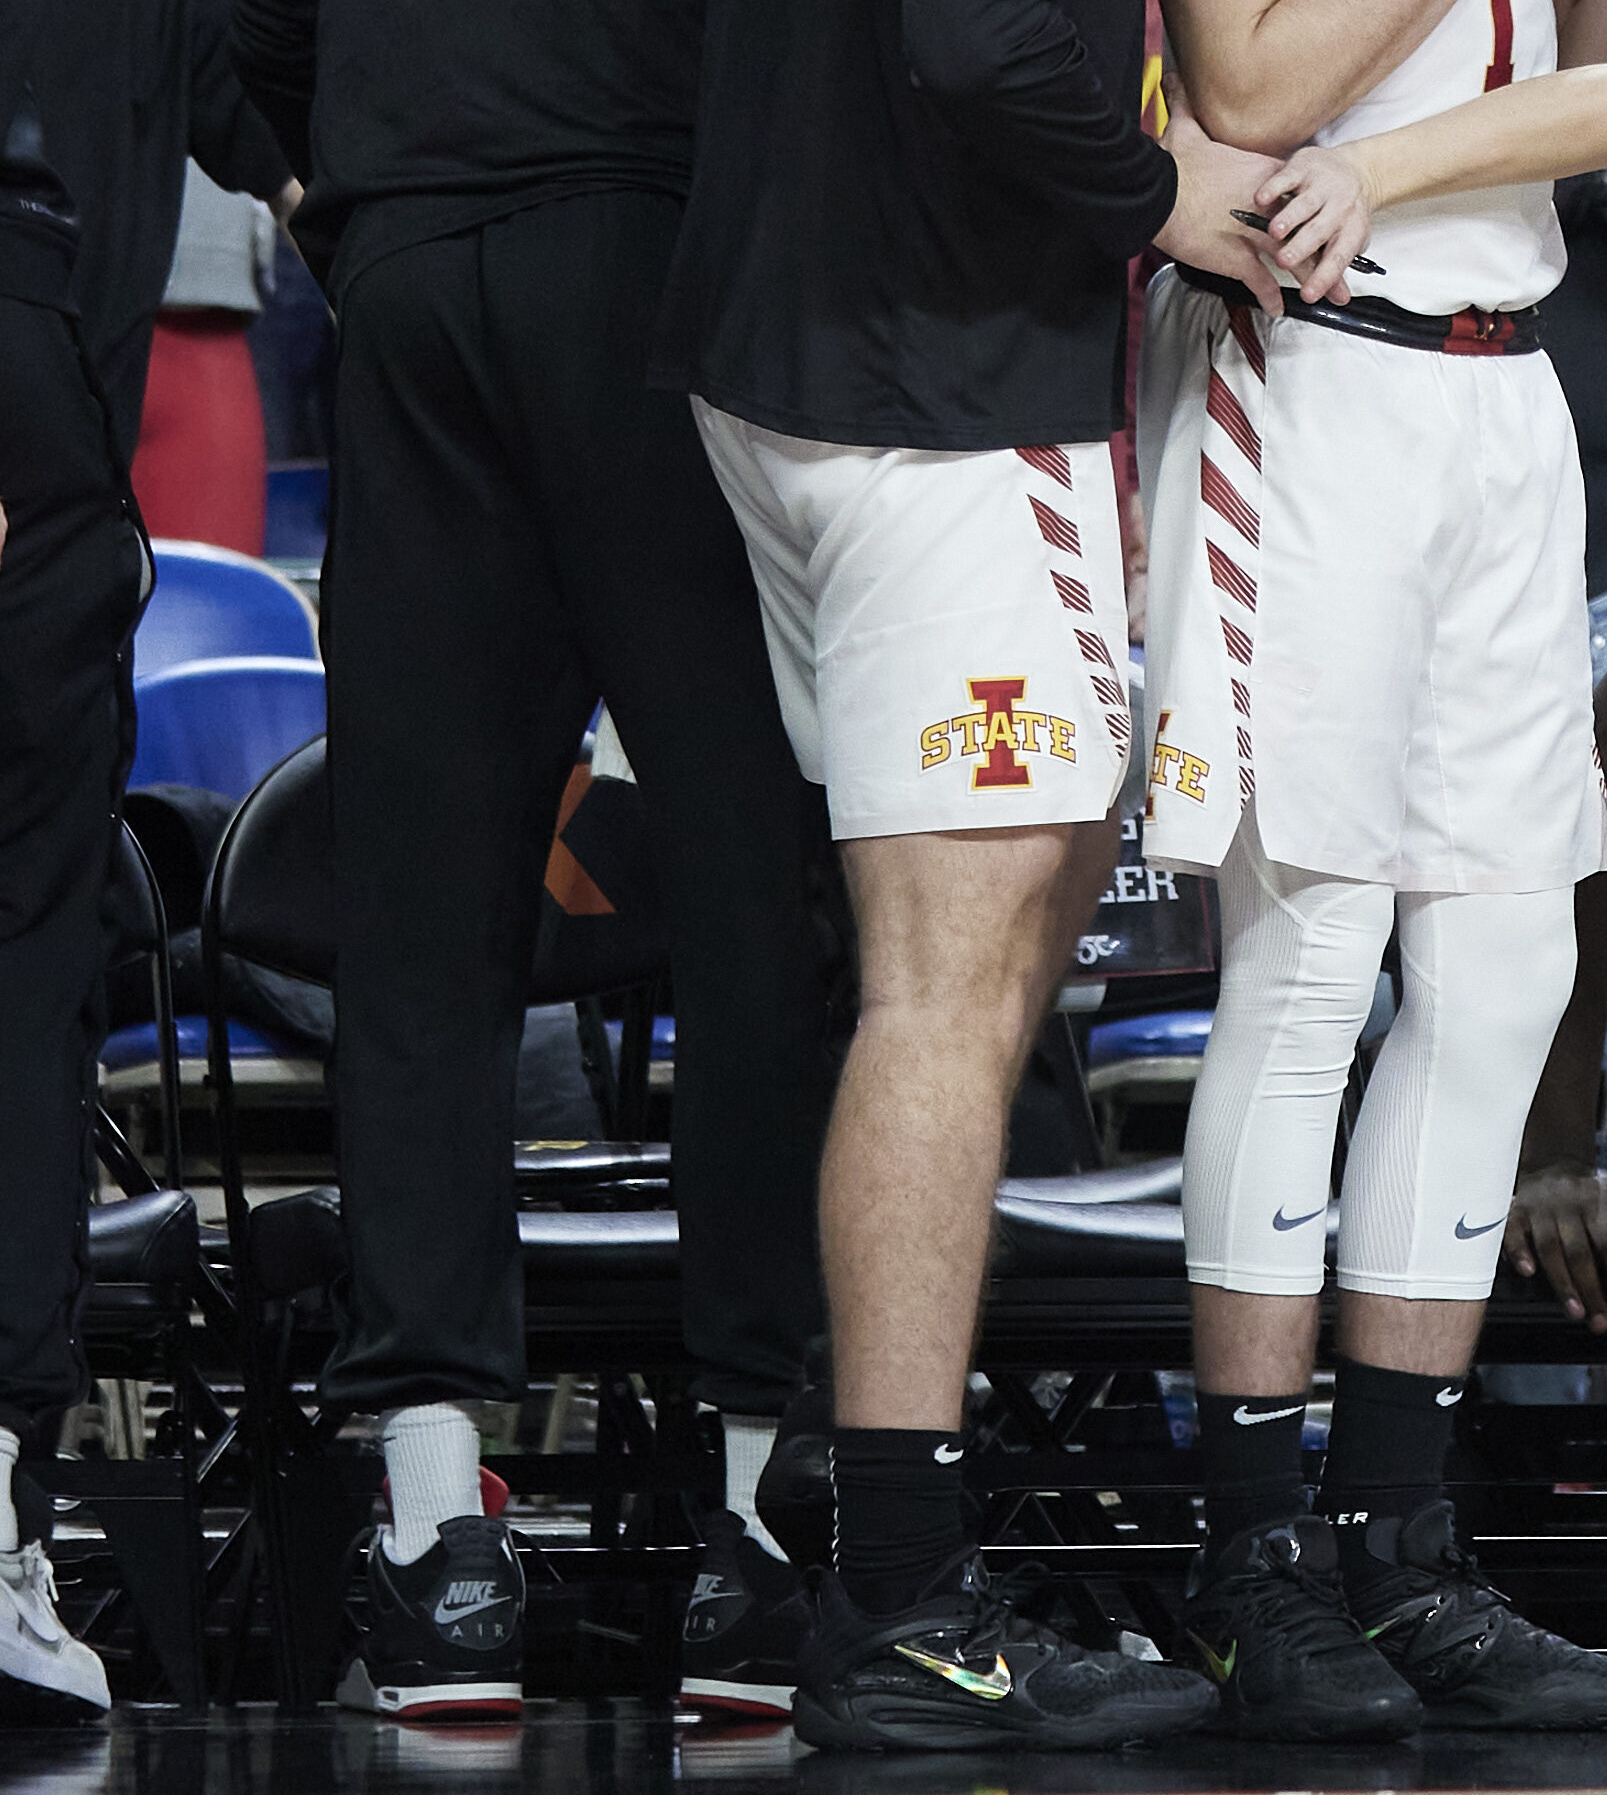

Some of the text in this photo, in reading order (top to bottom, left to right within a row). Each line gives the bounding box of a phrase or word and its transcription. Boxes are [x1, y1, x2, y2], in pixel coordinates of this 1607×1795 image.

[919, 710, 1077, 771] STATE
[446, 1580, 497, 1604] NIKE
[451, 1624, 505, 1638] AIR
